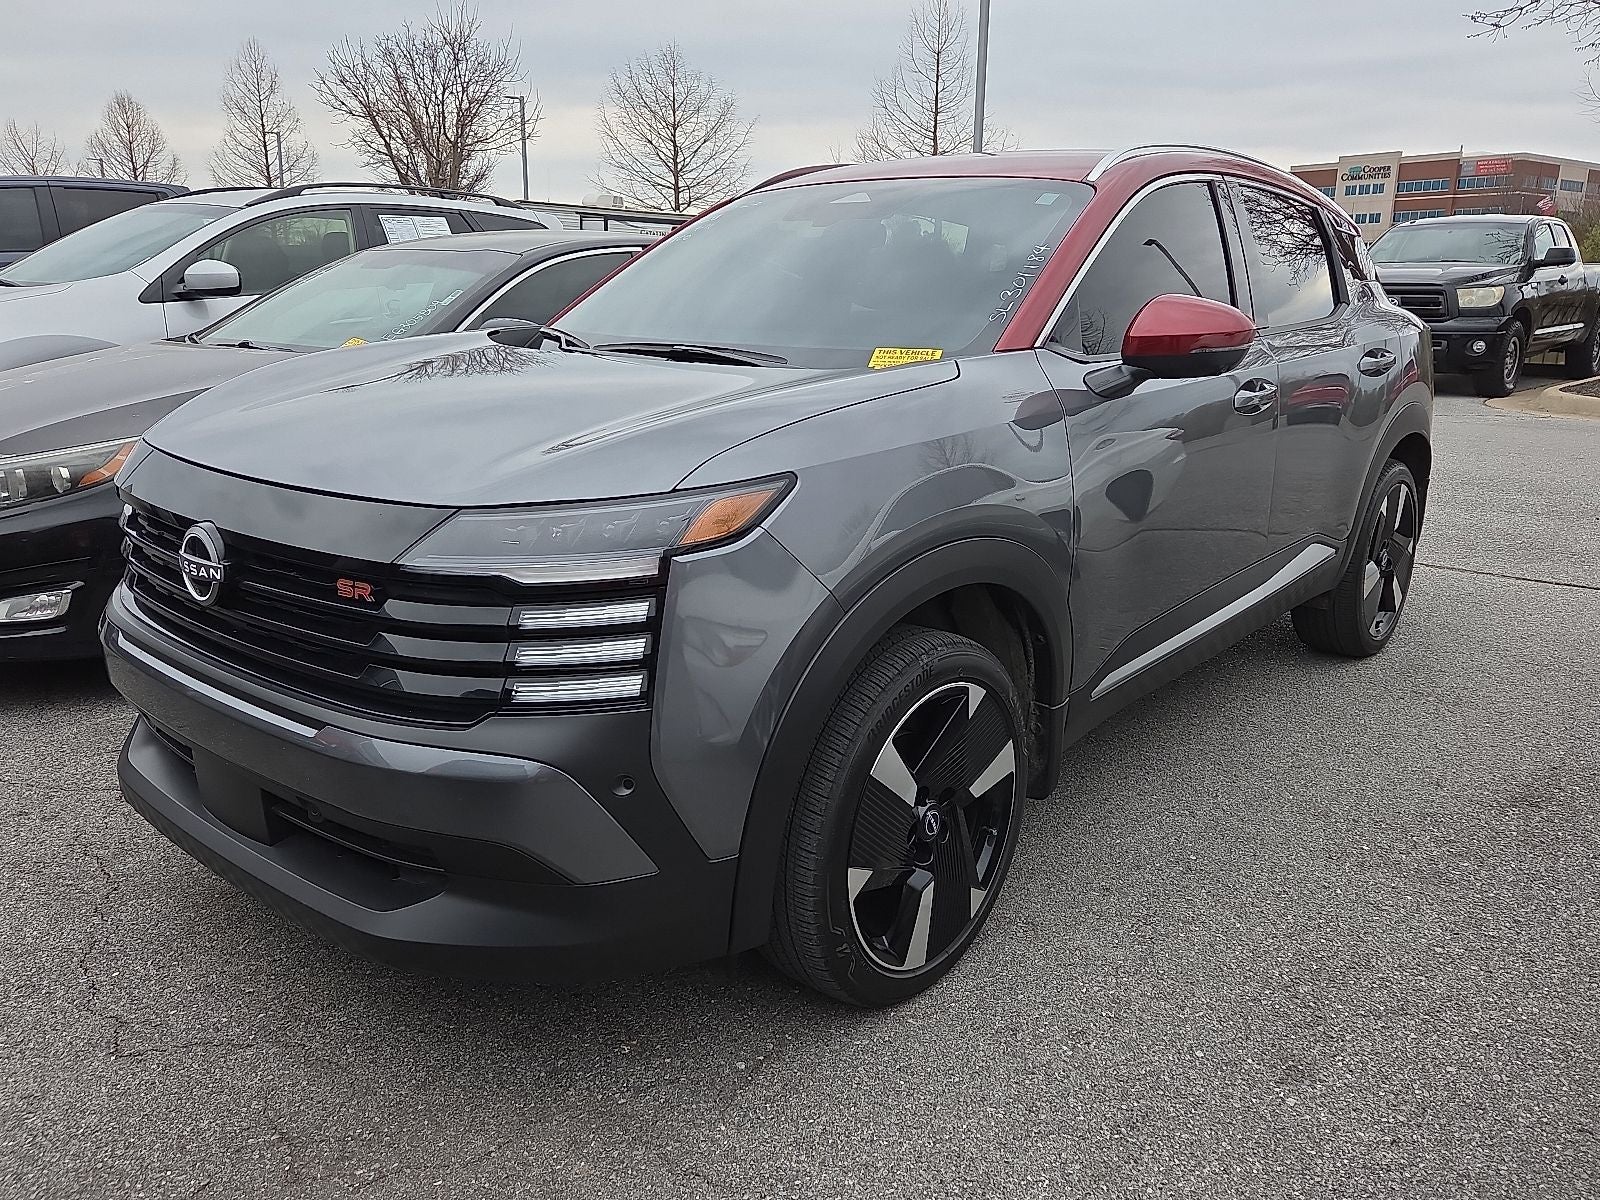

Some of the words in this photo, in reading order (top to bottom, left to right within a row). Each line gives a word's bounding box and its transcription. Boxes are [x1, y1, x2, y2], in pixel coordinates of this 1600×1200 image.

[1363, 165, 1391, 173] COOPER
[1341, 172, 1391, 181] COMMUNITIES
[640, 229, 668, 237] CATALIN
[989, 243, 1051, 324] SL301184
[181, 560, 221, 580] SSAN
[336, 578, 375, 602] SR
